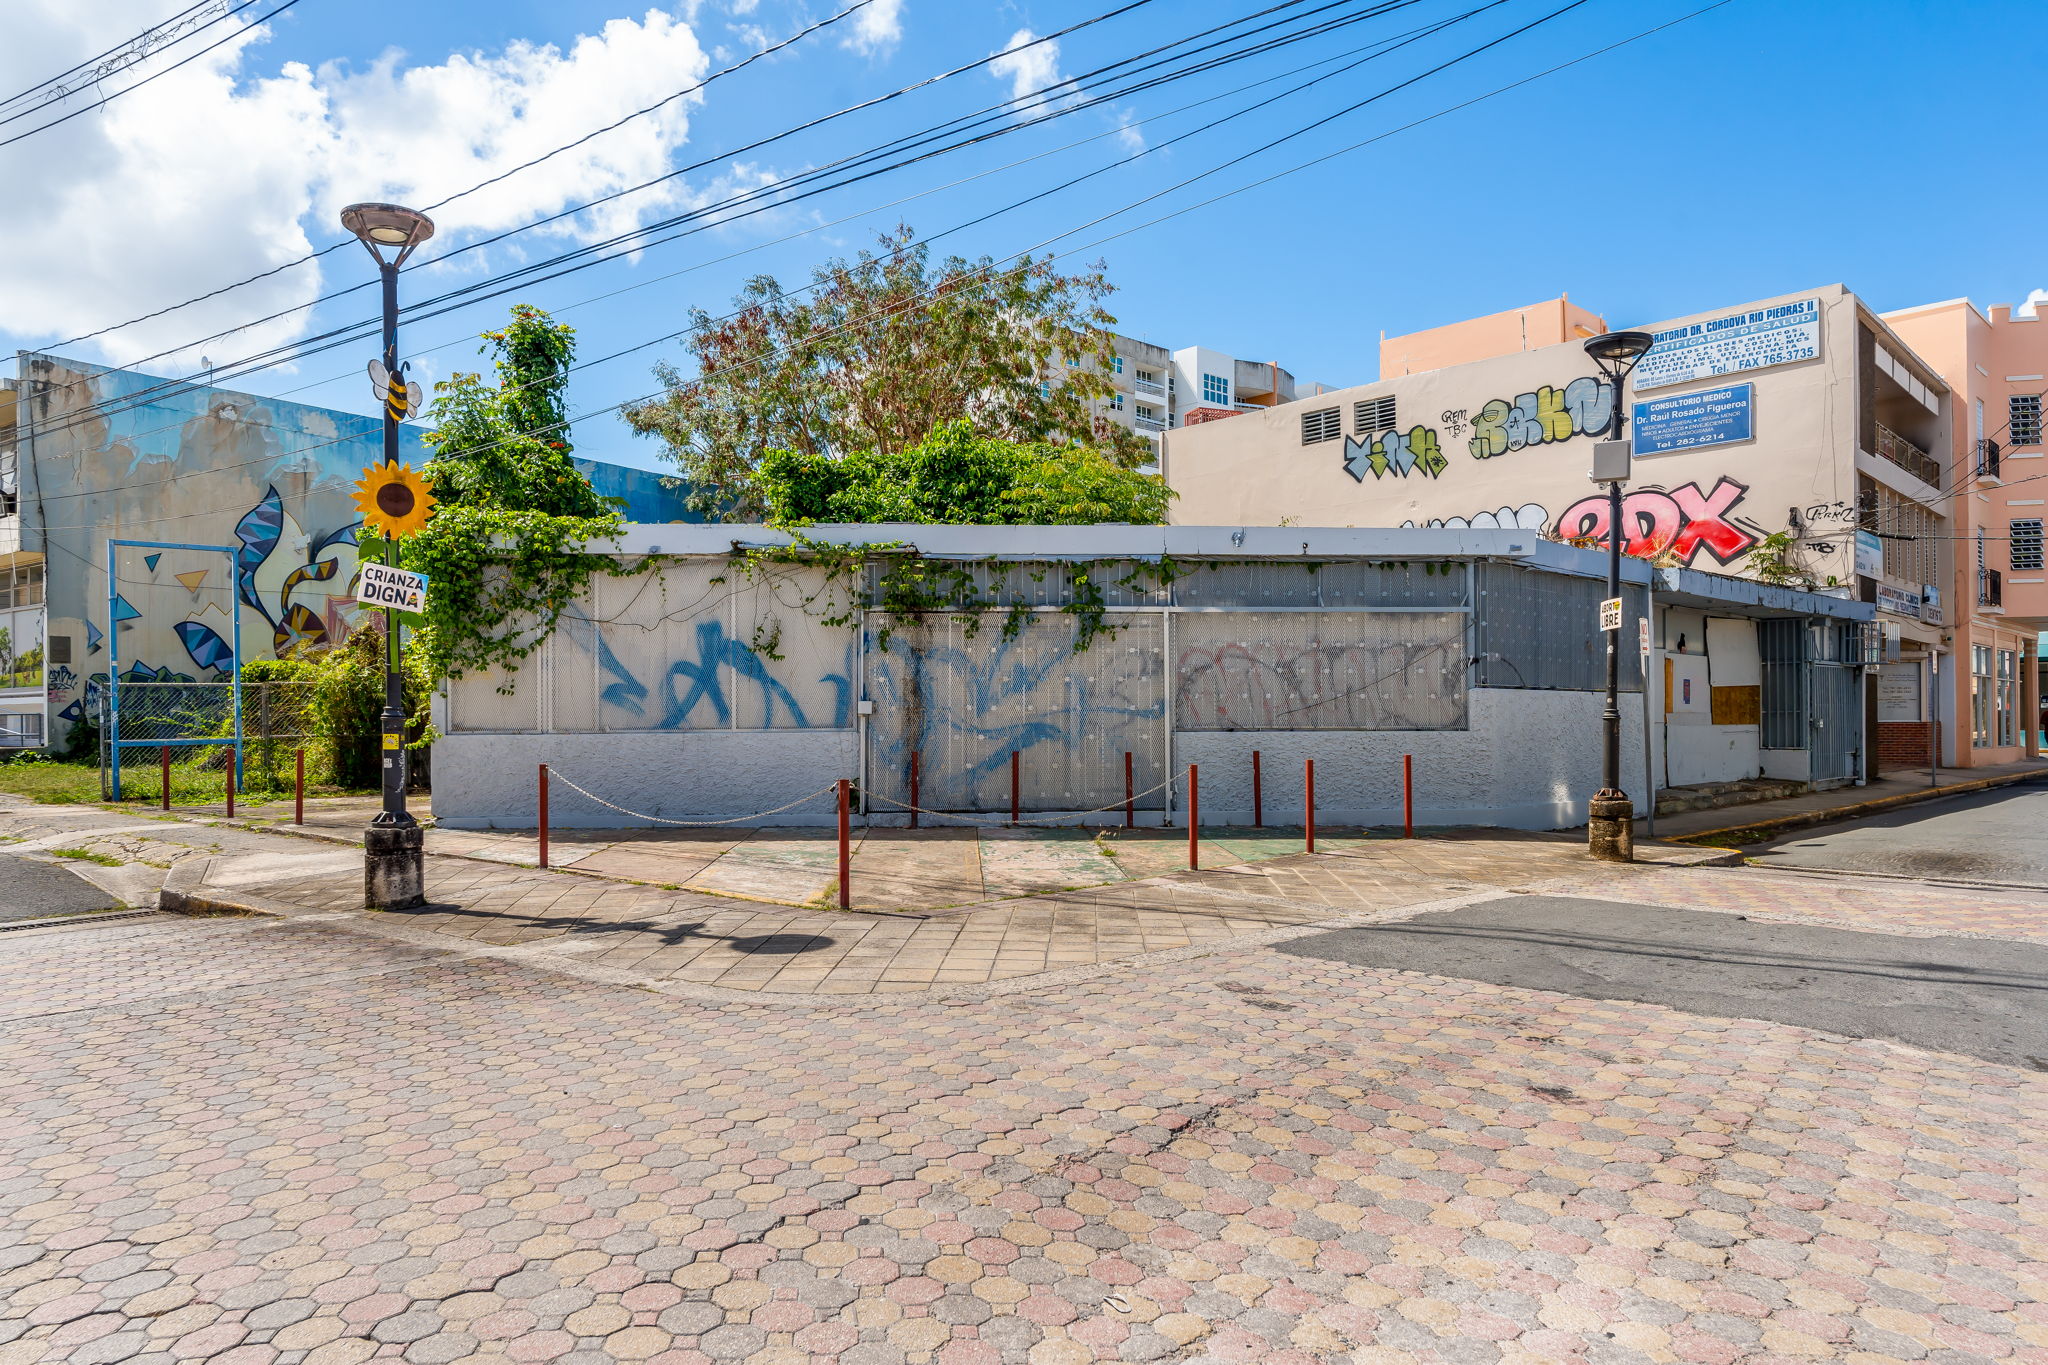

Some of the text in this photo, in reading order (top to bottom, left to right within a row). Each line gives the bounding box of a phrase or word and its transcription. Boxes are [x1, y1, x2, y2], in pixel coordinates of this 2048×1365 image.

[1654, 300, 1814, 343] RATORIO DR. CORDOVA RIO PIEDRAS II
[1647, 315, 1811, 353] ERTIFICADOS DE SALUD
[1645, 353, 1678, 362] TODOS
[1703, 339, 1744, 351] PLANES
[1658, 362, 1705, 375] PRUEBAS
[1725, 344, 1798, 361] EMERGENCIA
[1711, 363, 1729, 375] Tel.
[1739, 357, 1760, 369] FAX
[1763, 346, 1814, 365] 765-3735
[1636, 400, 1747, 425] Dr. Raúl Rosado Figueroa
[1650, 391, 1732, 412] CONSULTORIO MEDICO
[1641, 423, 1667, 431] MEDICINA
[1669, 418, 1693, 427] GENERAL
[1720, 411, 1741, 419] MENOR
[1661, 425, 1685, 434] ADULTOS
[1656, 432, 1725, 449] Tel. 282-6214
[365, 568, 424, 591] CRIANZA
[363, 582, 418, 608] DIGNA
[1601, 600, 1621, 613] ABORT
[1601, 613, 1619, 628] LIBRE
